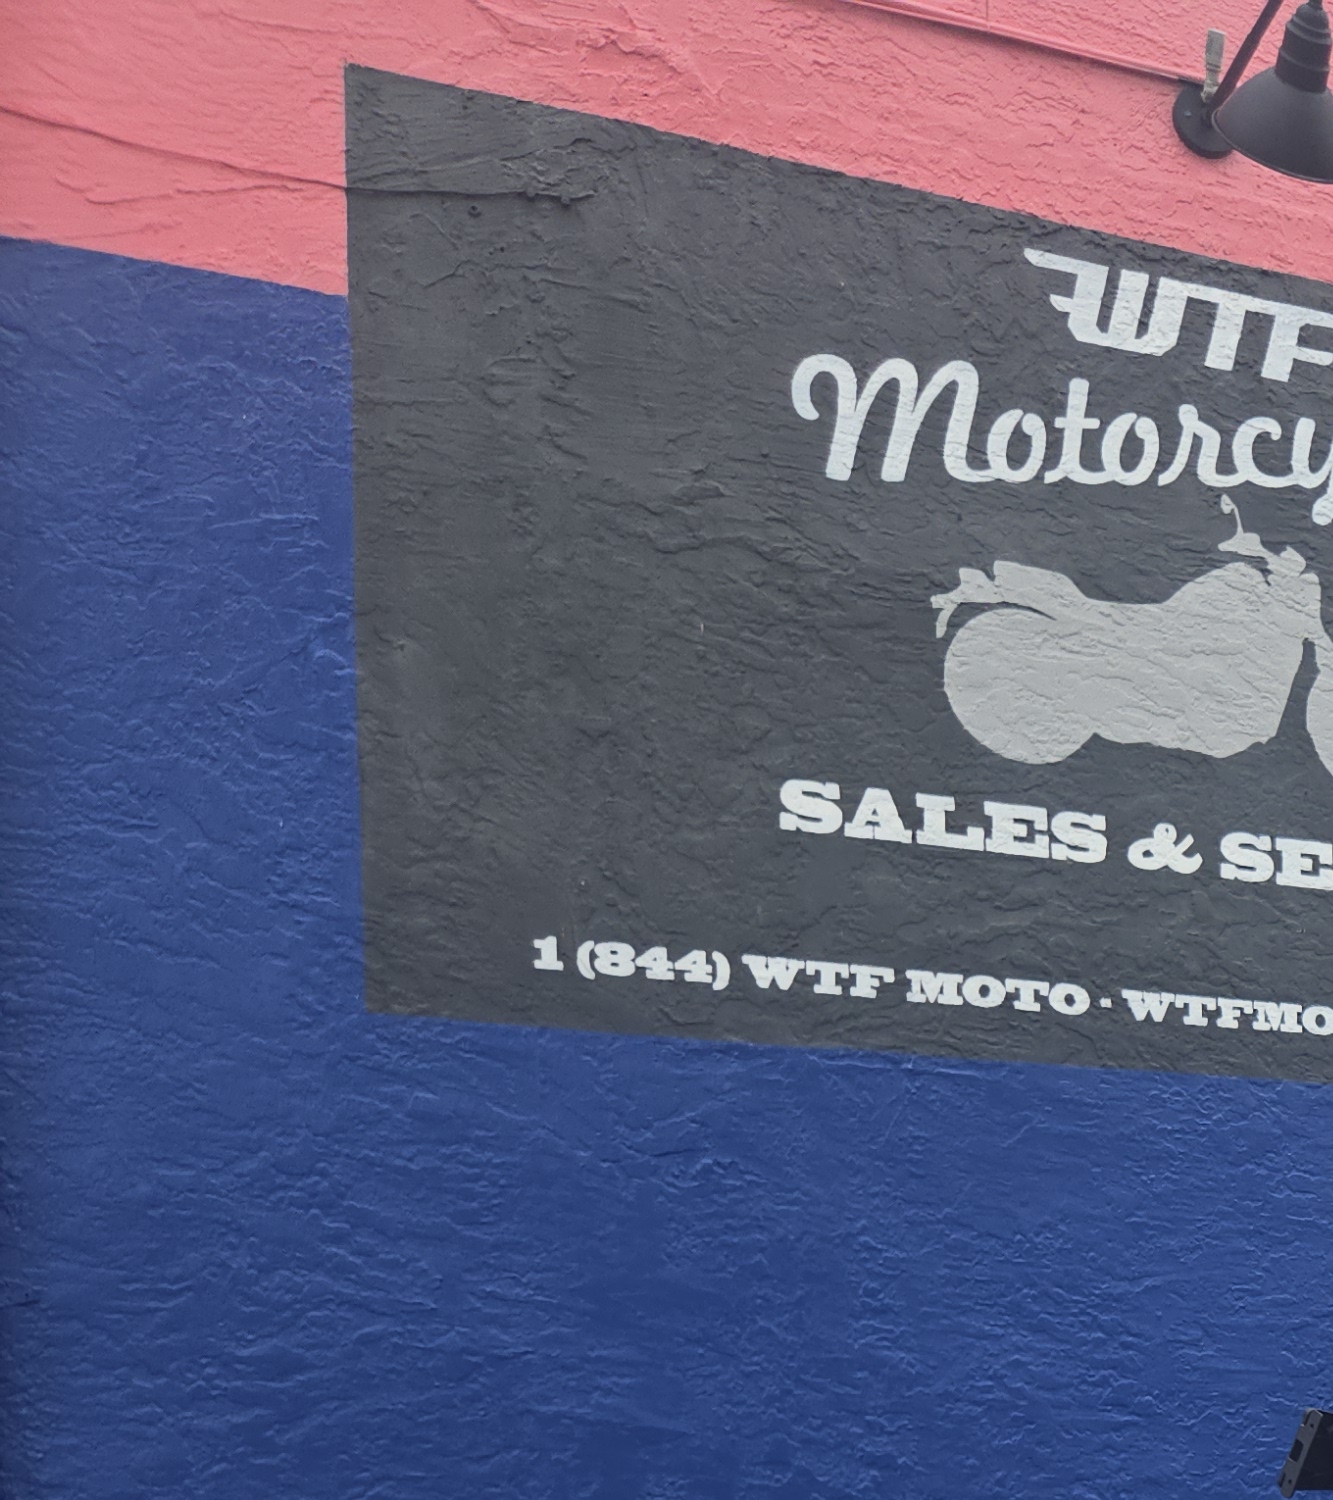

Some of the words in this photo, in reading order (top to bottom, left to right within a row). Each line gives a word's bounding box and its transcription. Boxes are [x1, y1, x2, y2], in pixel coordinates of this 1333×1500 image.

[780, 779, 1107, 863] SALES
[1127, 823, 1203, 874] &
[534, 936, 563, 971] 1
[577, 940, 731, 990] (844)
[742, 955, 895, 998] WTF
[905, 969, 1091, 1016] MOTO
